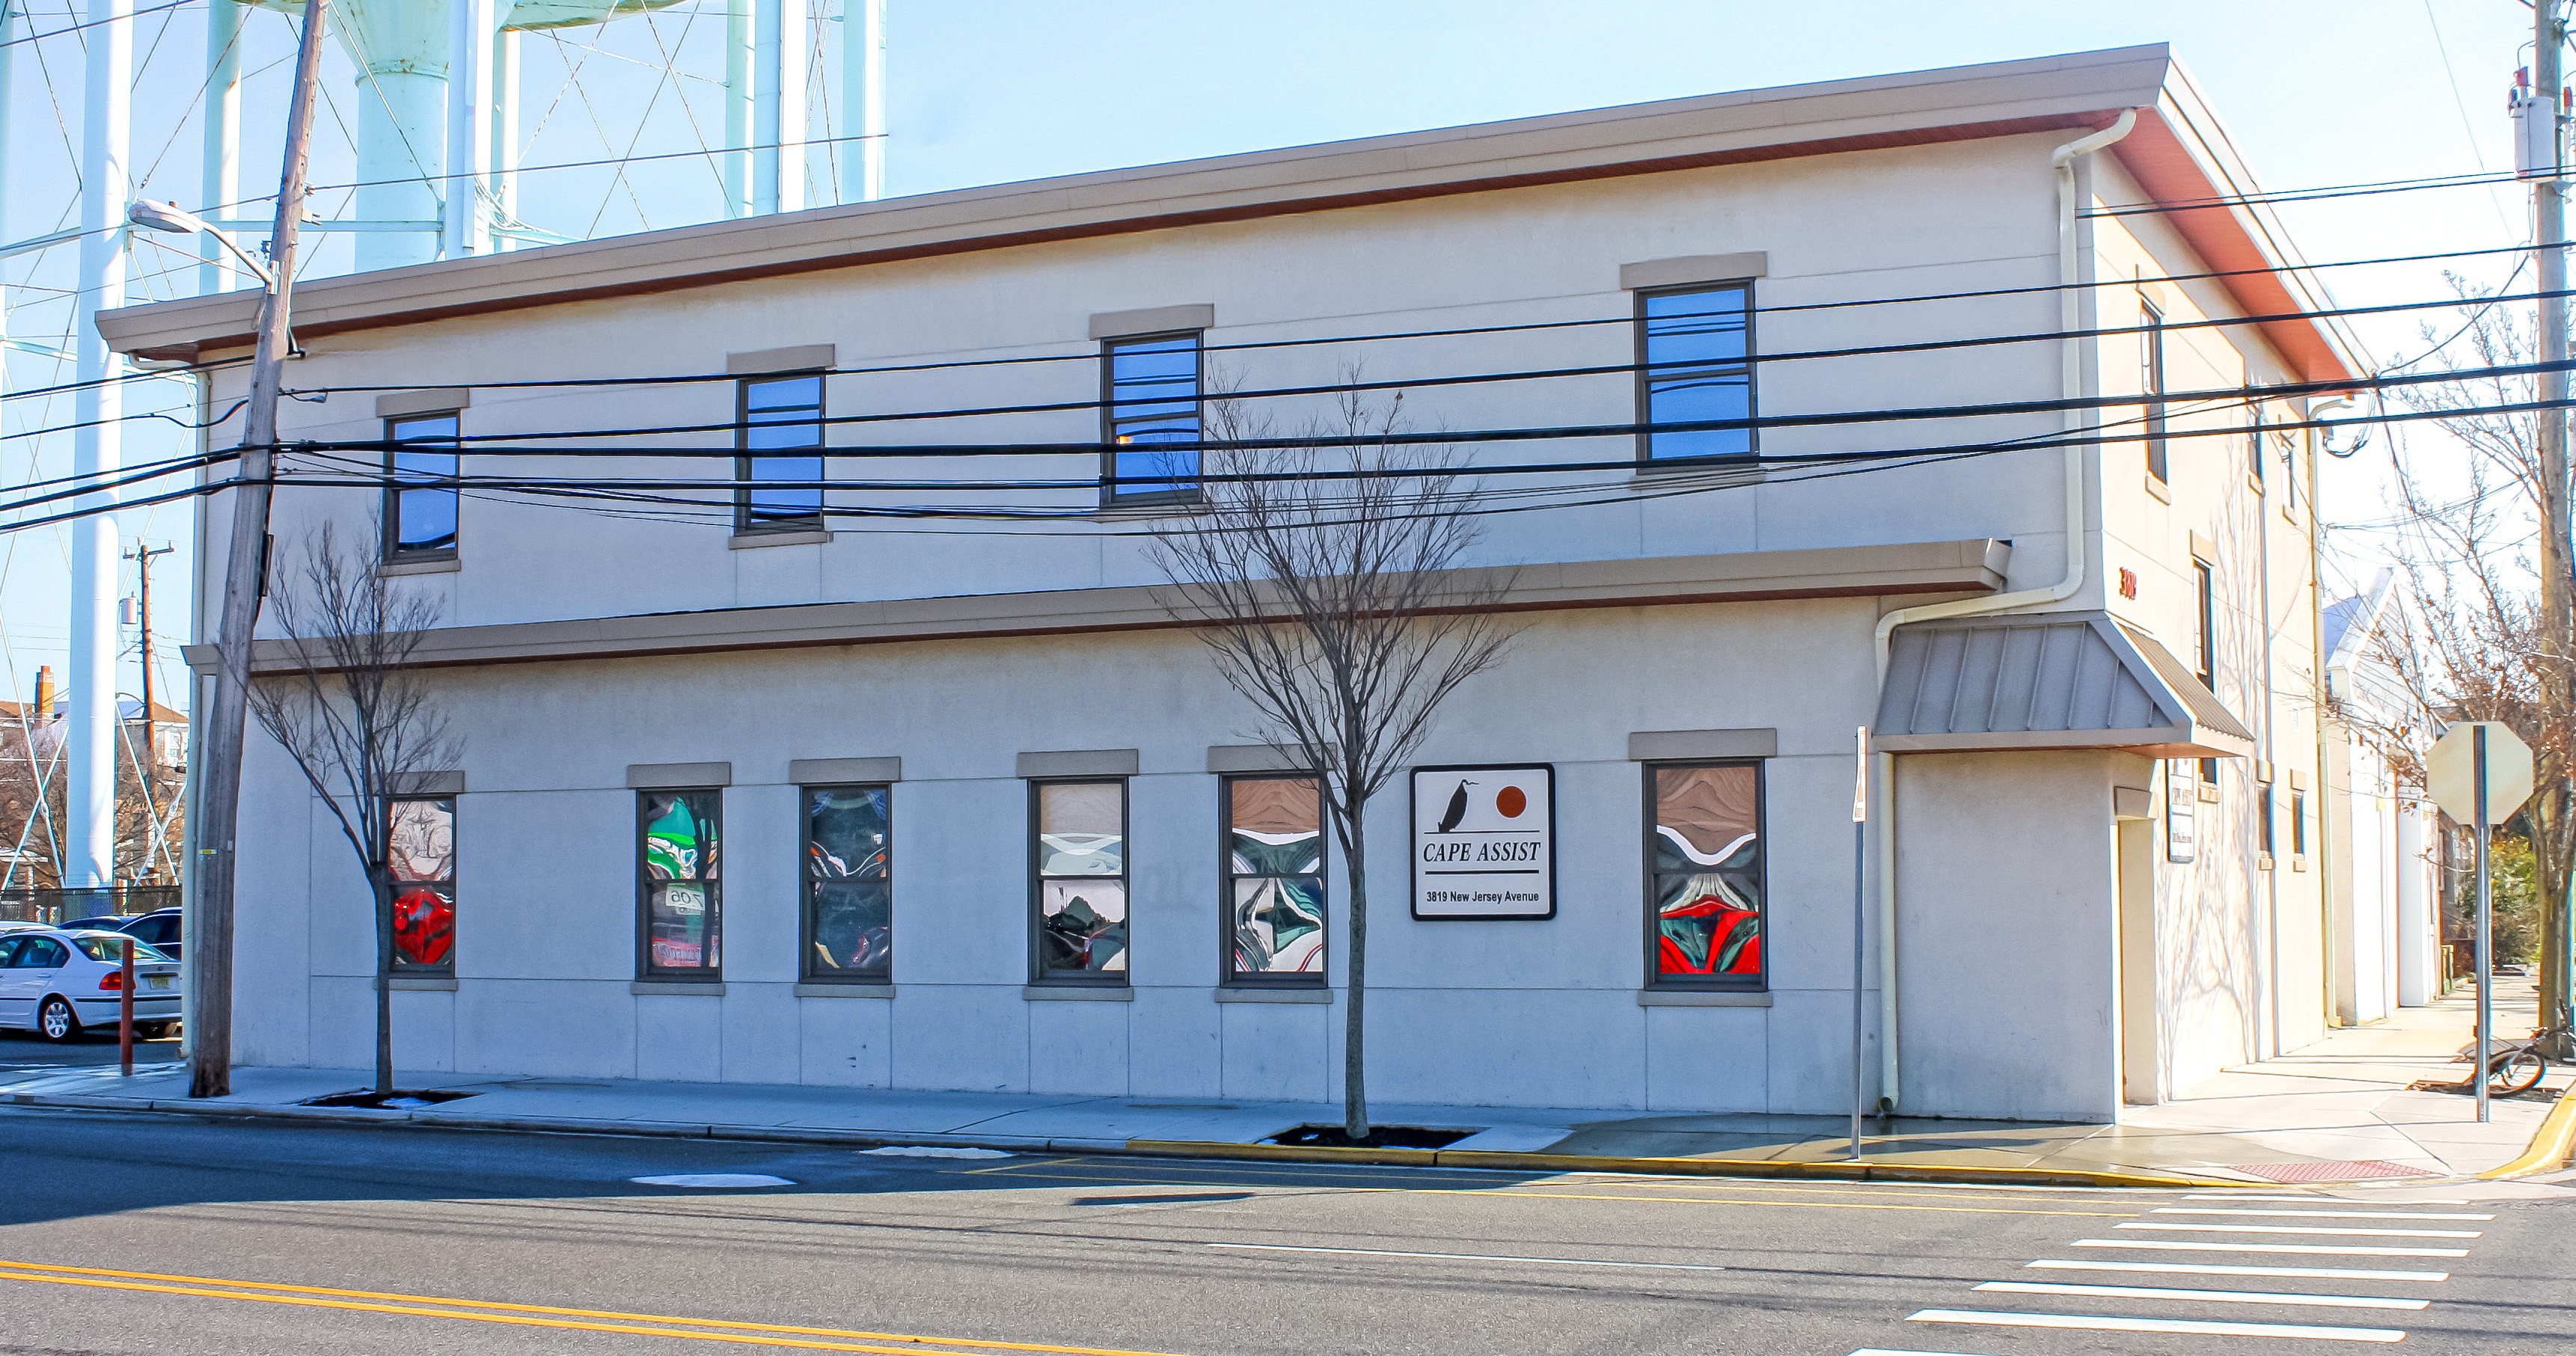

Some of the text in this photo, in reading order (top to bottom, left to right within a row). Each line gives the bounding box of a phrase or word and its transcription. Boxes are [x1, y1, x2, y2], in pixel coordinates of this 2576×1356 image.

[1423, 842, 1541, 862] CAPE ASSIST
[1426, 890, 1539, 904] 3819 New Jersey Avenue
